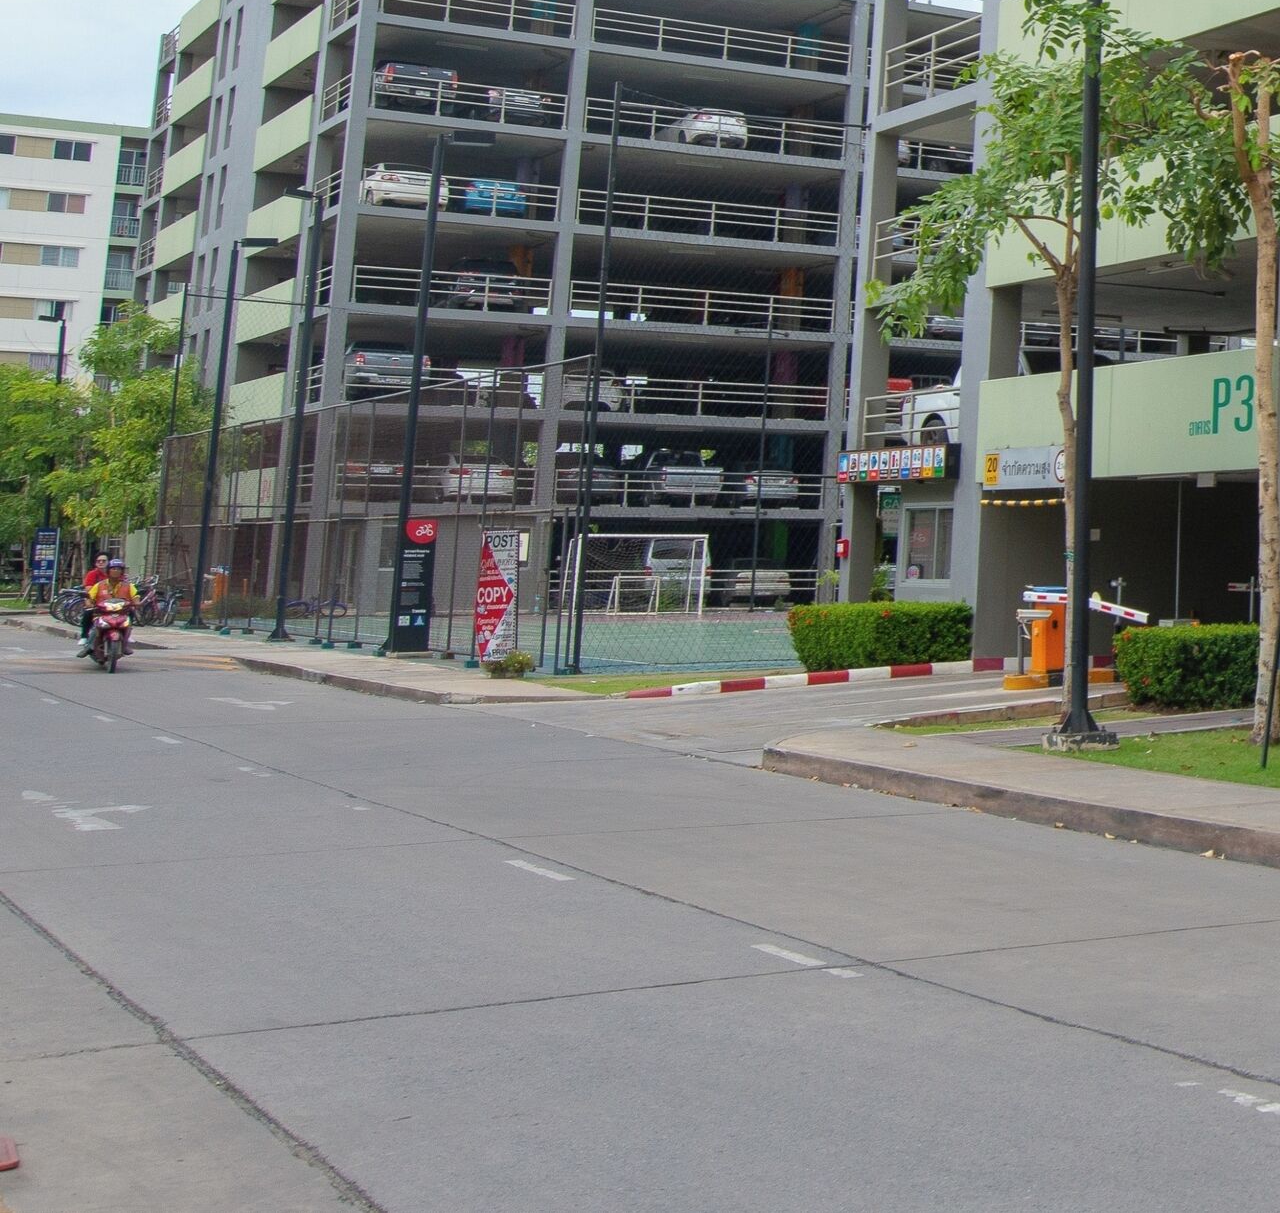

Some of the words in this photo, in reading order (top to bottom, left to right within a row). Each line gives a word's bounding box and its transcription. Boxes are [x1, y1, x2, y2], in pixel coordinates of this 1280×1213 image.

[1189, 420, 1211, 436] อาคาร
[1212, 375, 1254, 434] P3
[987, 458, 998, 473] 20
[1001, 460, 1051, 480] จำกัดความสูง
[883, 499, 900, 508] CA
[486, 534, 515, 548] POST
[477, 586, 509, 603] COPY
